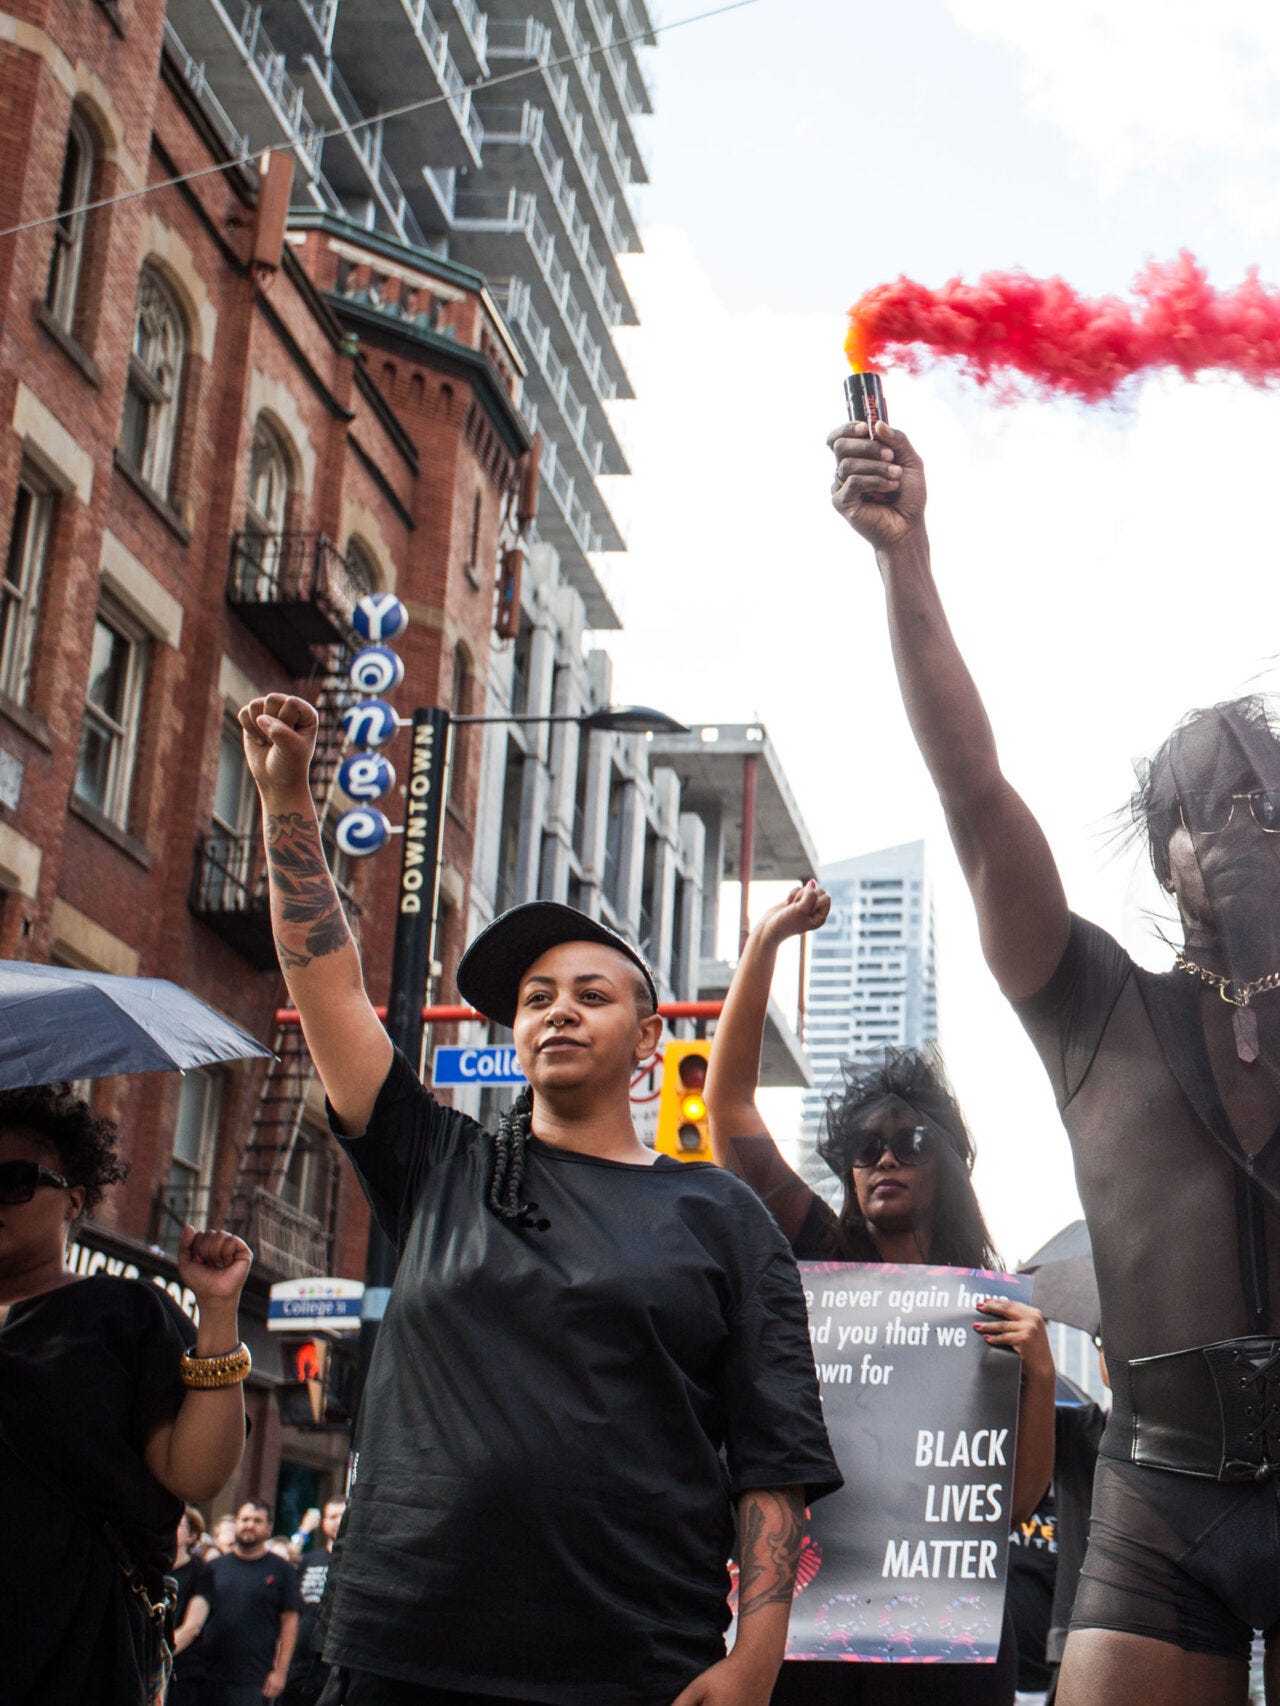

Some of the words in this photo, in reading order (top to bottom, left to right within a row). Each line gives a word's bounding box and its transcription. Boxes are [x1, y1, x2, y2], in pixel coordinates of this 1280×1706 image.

[336, 593, 400, 857] Yonge
[401, 723, 436, 914] DOWNTOWN
[459, 1050, 525, 1077] Colle
[283, 1299, 334, 1317] College
[821, 1289, 882, 1309] never
[888, 1286, 949, 1314] again
[837, 1324, 878, 1351] you
[885, 1316, 931, 1347] that
[936, 1325, 967, 1347] we
[860, 1354, 894, 1385] for
[914, 1428, 1009, 1468] BLACK
[924, 1483, 1003, 1522] LIVES
[881, 1539, 998, 1579] MATTER
